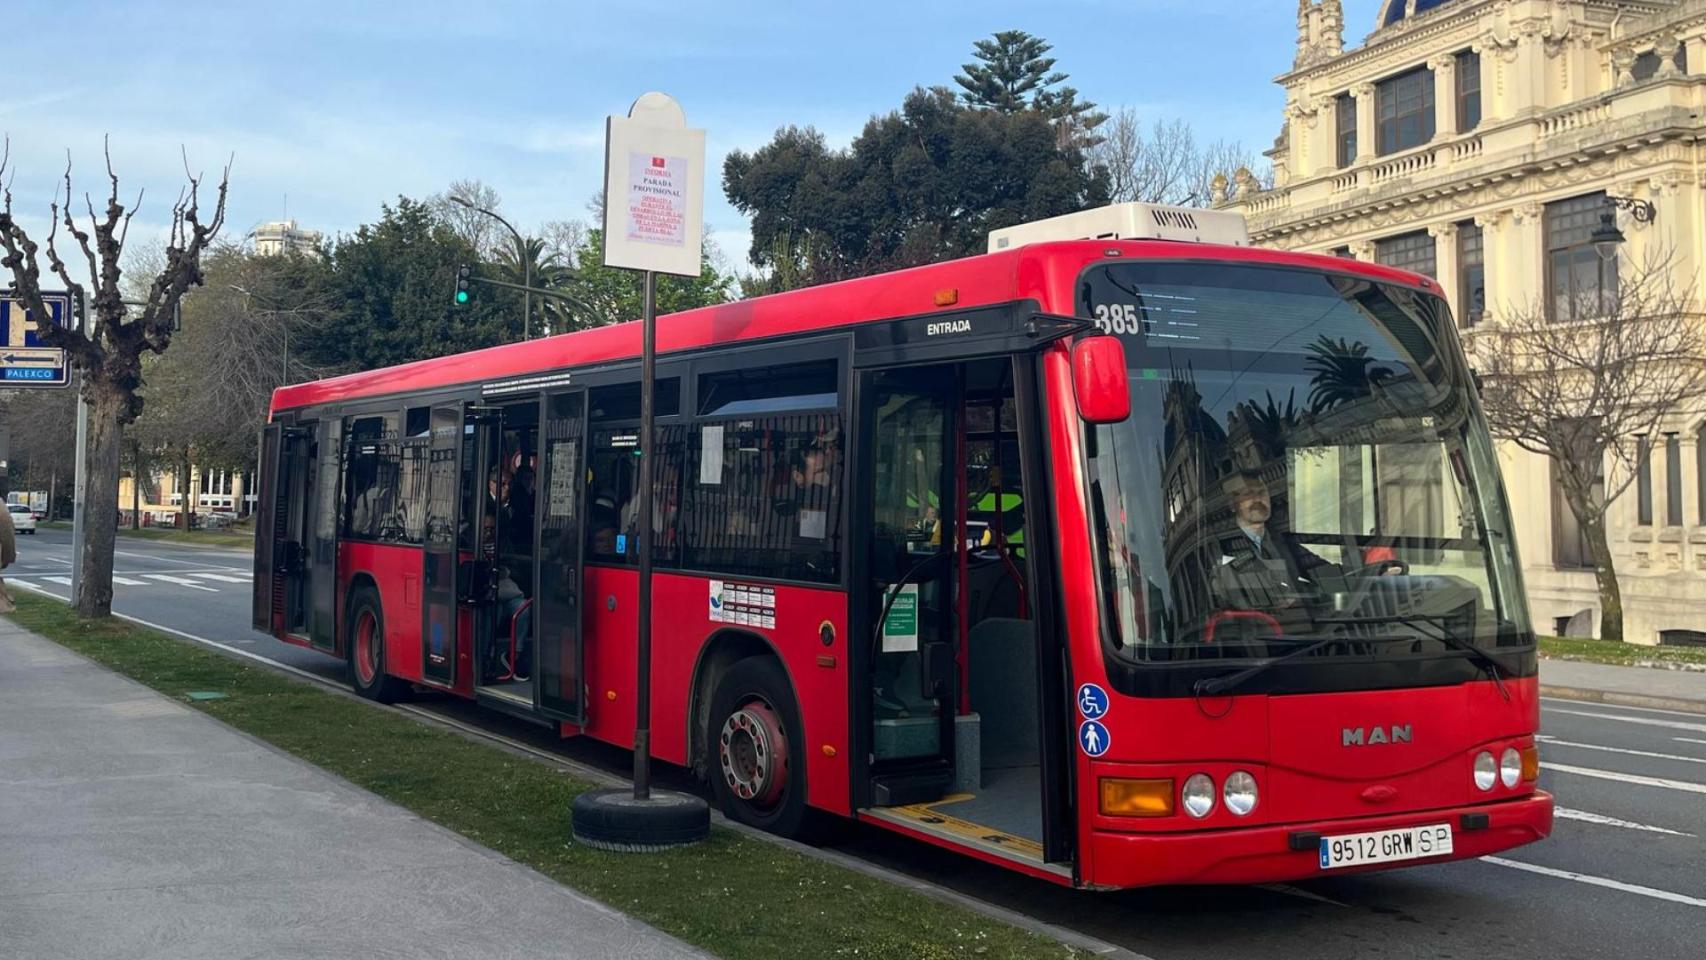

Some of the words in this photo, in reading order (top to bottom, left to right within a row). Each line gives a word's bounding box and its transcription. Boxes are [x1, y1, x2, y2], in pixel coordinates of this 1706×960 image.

[634, 185, 680, 197] PROVISIONAL
[643, 178, 672, 187] PARADA
[927, 319, 971, 336] ENTRADA
[1095, 304, 1138, 335] 385
[1343, 725, 1412, 746] MAN
[1333, 837, 1377, 863] 9512
[1382, 831, 1413, 857] GRW
